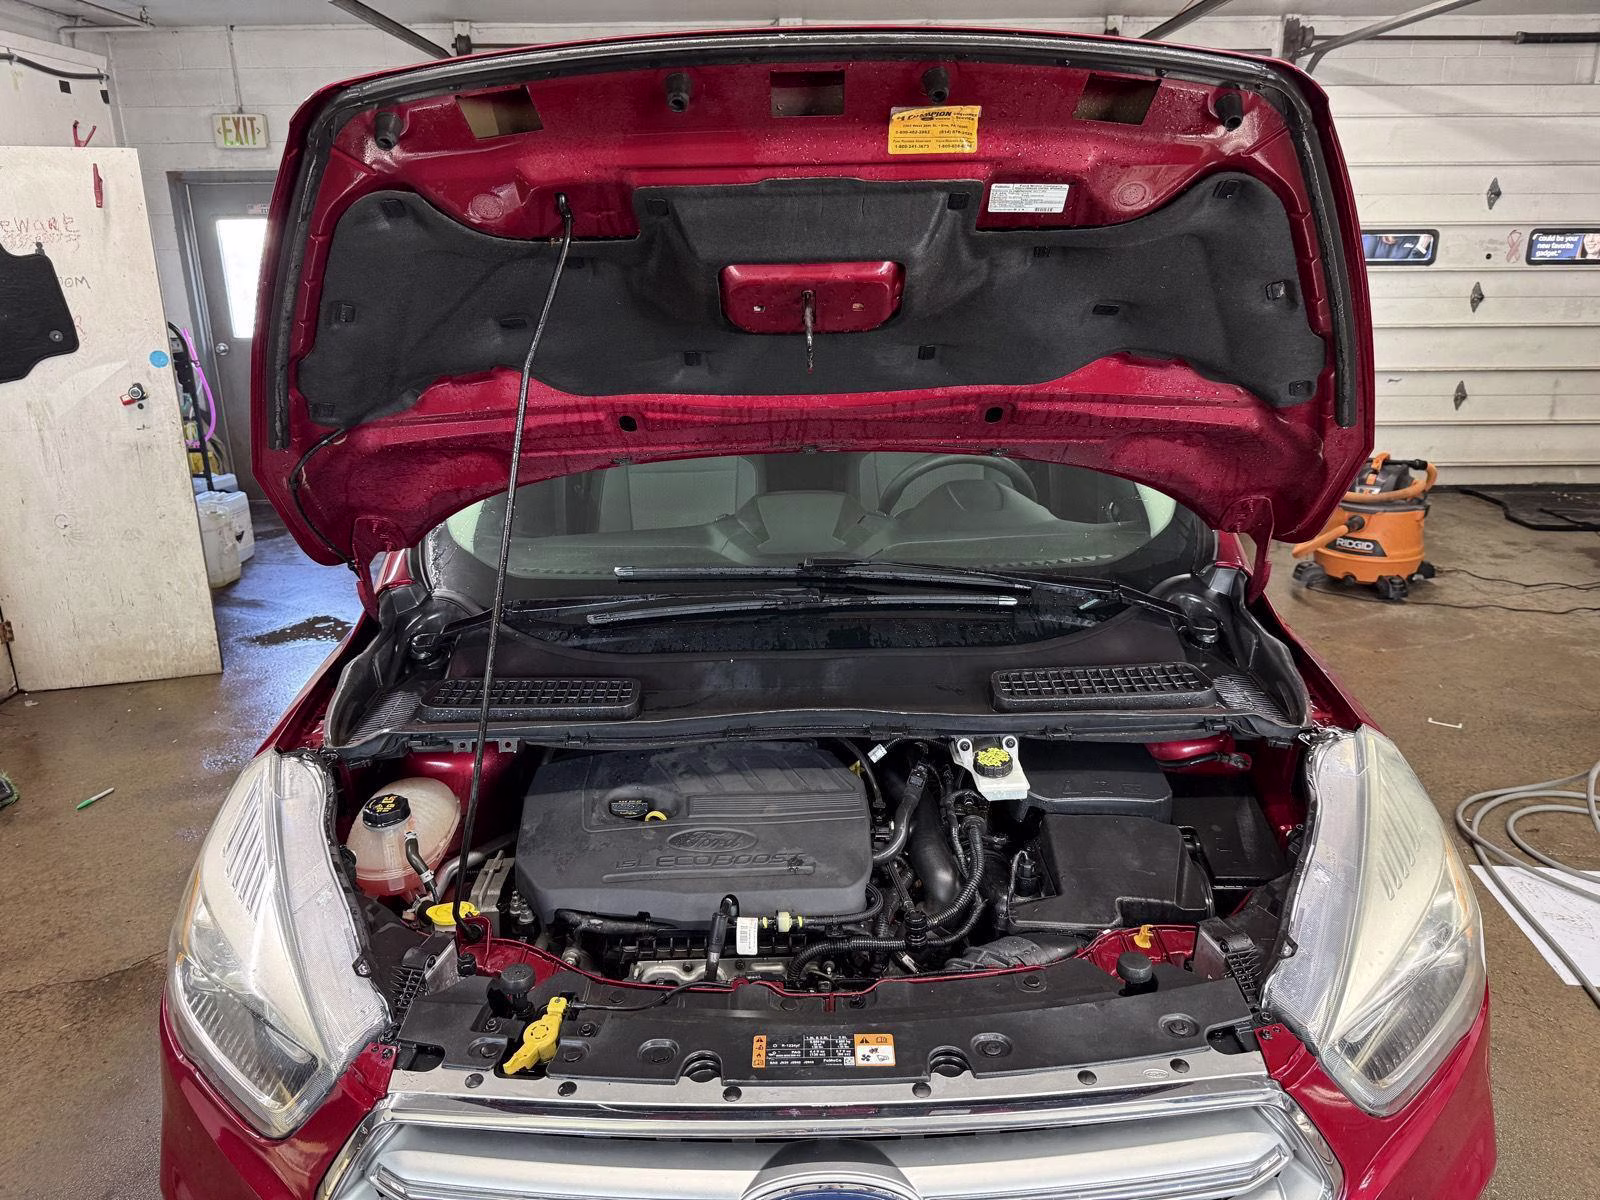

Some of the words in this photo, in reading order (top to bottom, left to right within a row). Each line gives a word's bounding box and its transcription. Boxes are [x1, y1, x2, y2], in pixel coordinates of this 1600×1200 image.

[907, 111, 952, 121] CHAMPION
[221, 116, 257, 145] EXIT
[1336, 538, 1374, 550] RIDGID
